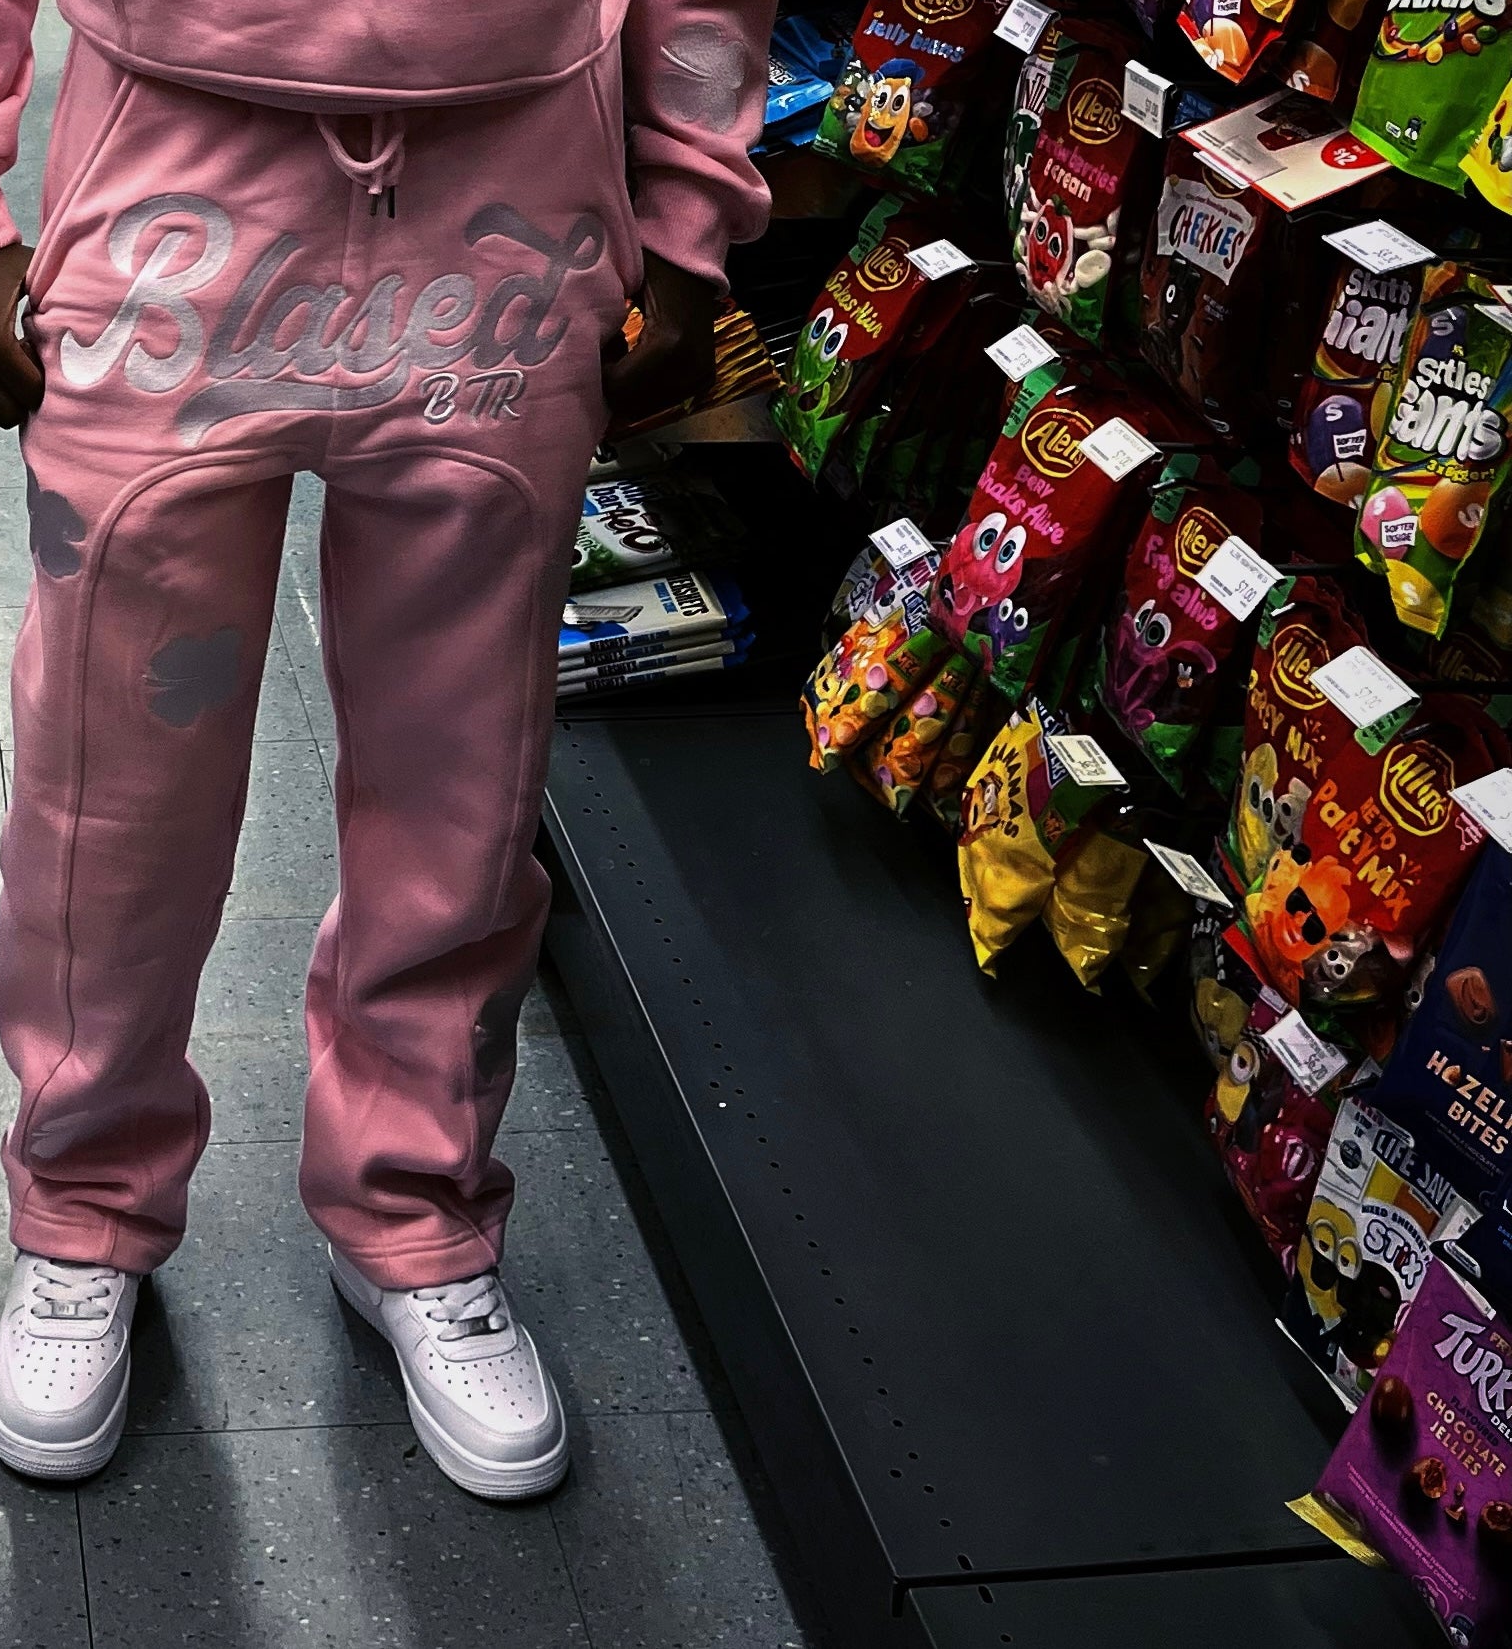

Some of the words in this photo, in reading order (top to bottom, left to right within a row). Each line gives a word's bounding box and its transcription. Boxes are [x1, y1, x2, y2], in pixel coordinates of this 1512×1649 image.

[59, 192, 605, 412] Blased
[418, 368, 527, 425] BTR
[1384, 522, 1416, 534] SOFTER
[1385, 532, 1413, 543] INSIDE
[1372, 1129, 1416, 1176] LIFE
[1447, 1100, 1509, 1155] BITES
[1434, 1312, 1512, 1414] TURK
[1426, 1391, 1508, 1479] CHOCOLATE
[1429, 1420, 1482, 1477] JELLIES
